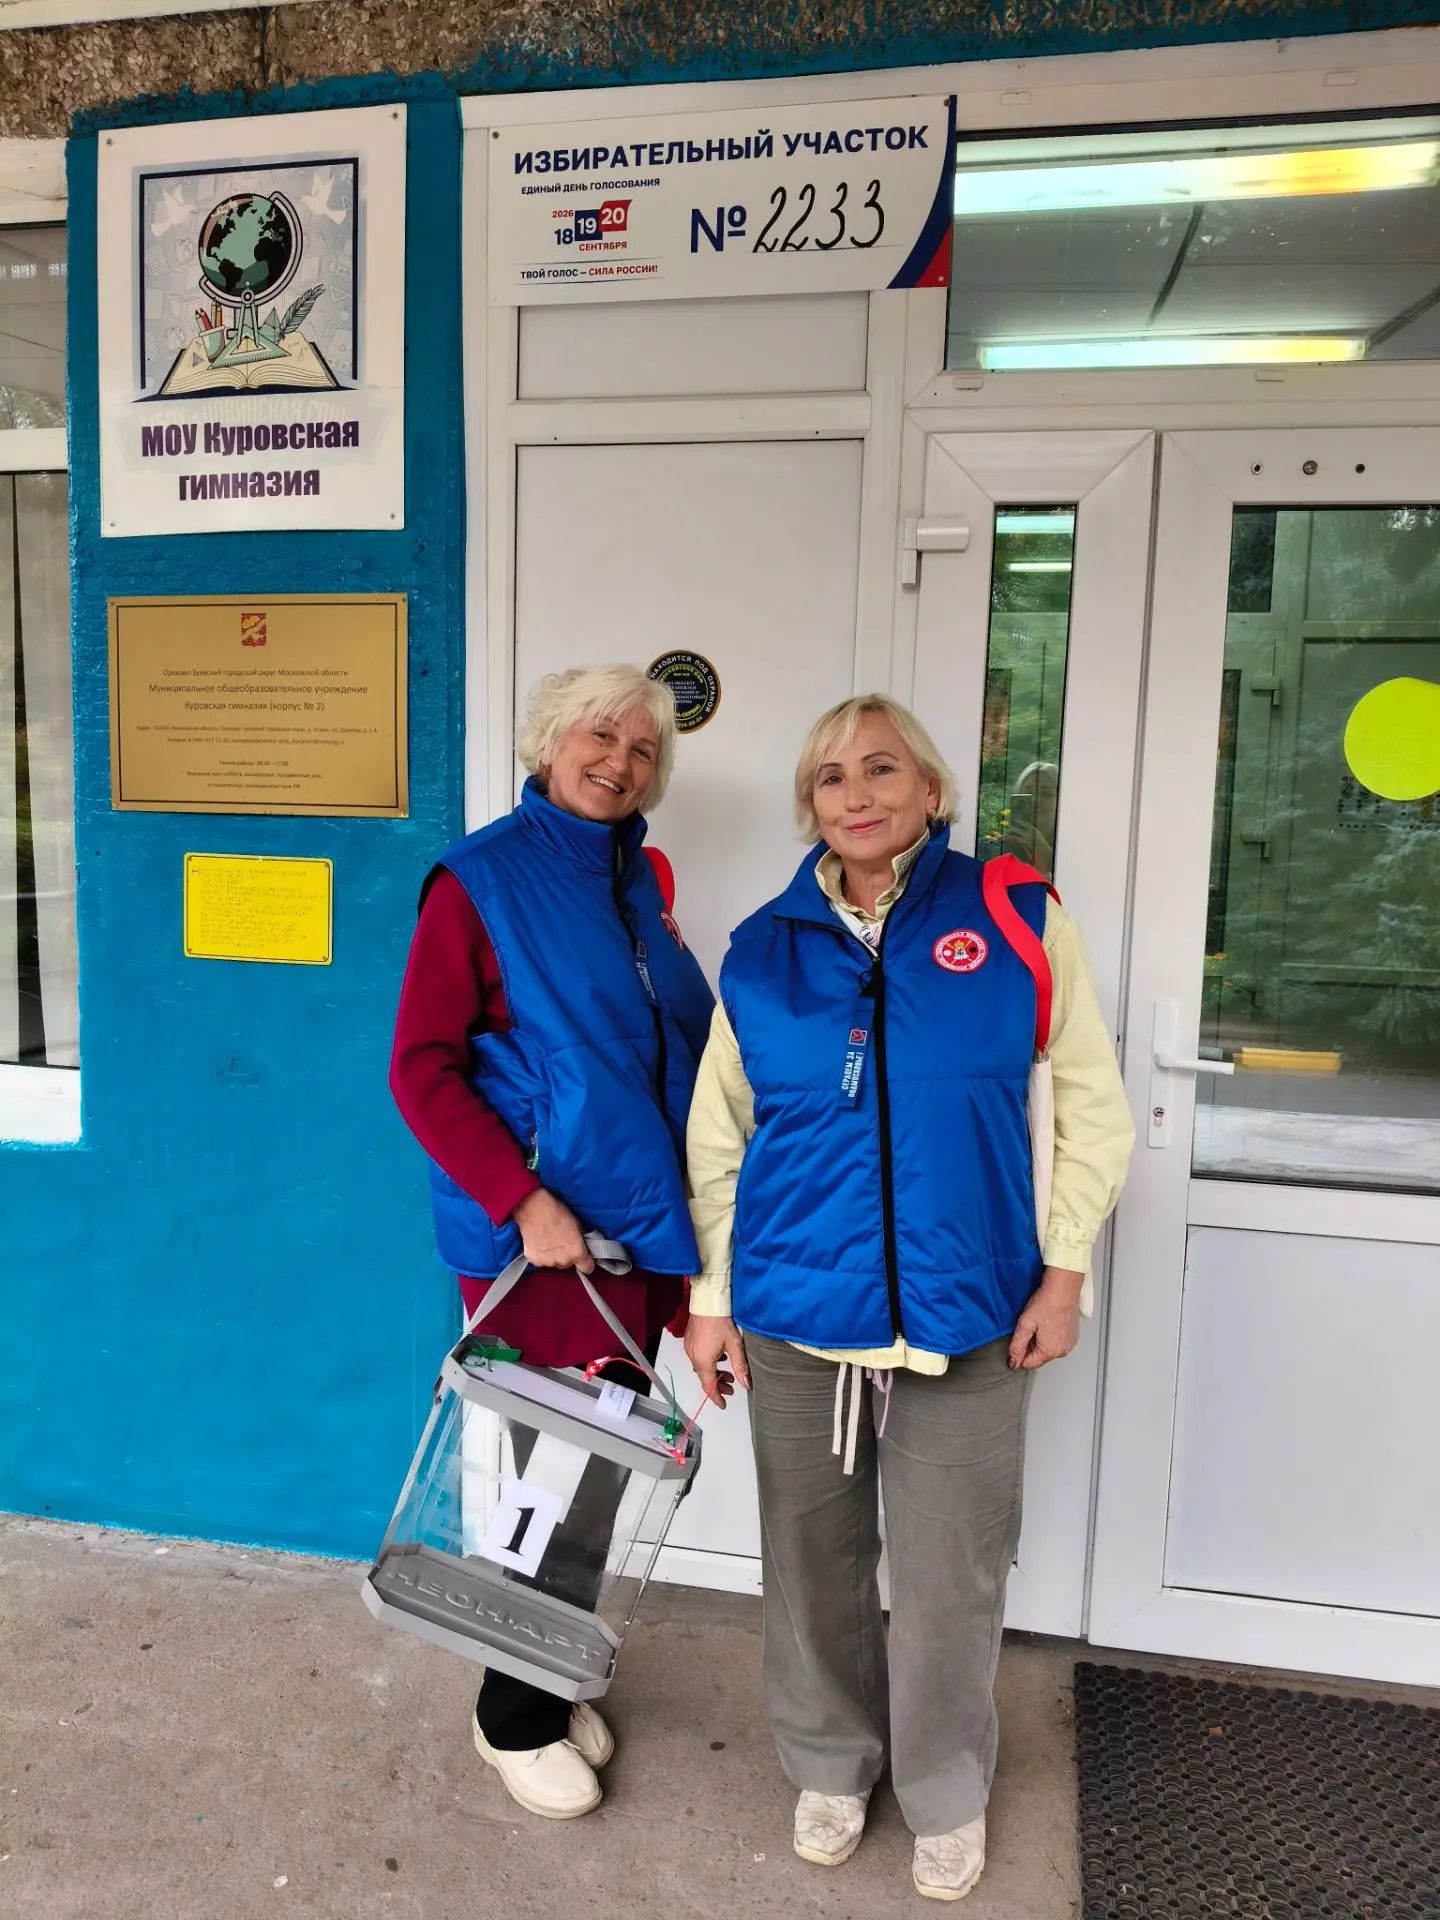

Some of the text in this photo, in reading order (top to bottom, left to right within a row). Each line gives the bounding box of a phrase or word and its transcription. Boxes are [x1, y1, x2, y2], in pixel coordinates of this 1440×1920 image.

[514, 125, 929, 174] ИЗБИРАТЕЛЬНЫЙ УЧАСТОК
[521, 178, 660, 195] ЕДИНЫЙ ДЕНЬ ГОЛОСОВАНИЯ
[552, 209, 574, 218] 2026
[554, 207, 625, 245] 18 19 20
[690, 205, 747, 253] №
[752, 179, 885, 253] 2233
[579, 241, 627, 251] СЕНТЯБРЯ
[521, 269, 545, 279] ТВОЙ
[547, 269, 578, 278] ГОЛОС
[588, 267, 614, 276] СИЛА
[616, 265, 658, 275] РОССИИ!
[141, 421, 359, 457] МОУ Куровская
[179, 470, 320, 501] гимназия
[321, 669, 348, 677] области
[650, 655, 692, 678] НАХОДИТСЯ
[694, 660, 709, 675] ПОД
[705, 675, 716, 713] ОХРАНОЙ
[149, 684, 368, 695] Муниципальное общеобразовательное учреждение
[184, 702, 226, 711] Куровская
[269, 702, 301, 712] (корпус
[500, 1506, 535, 1557] 1
